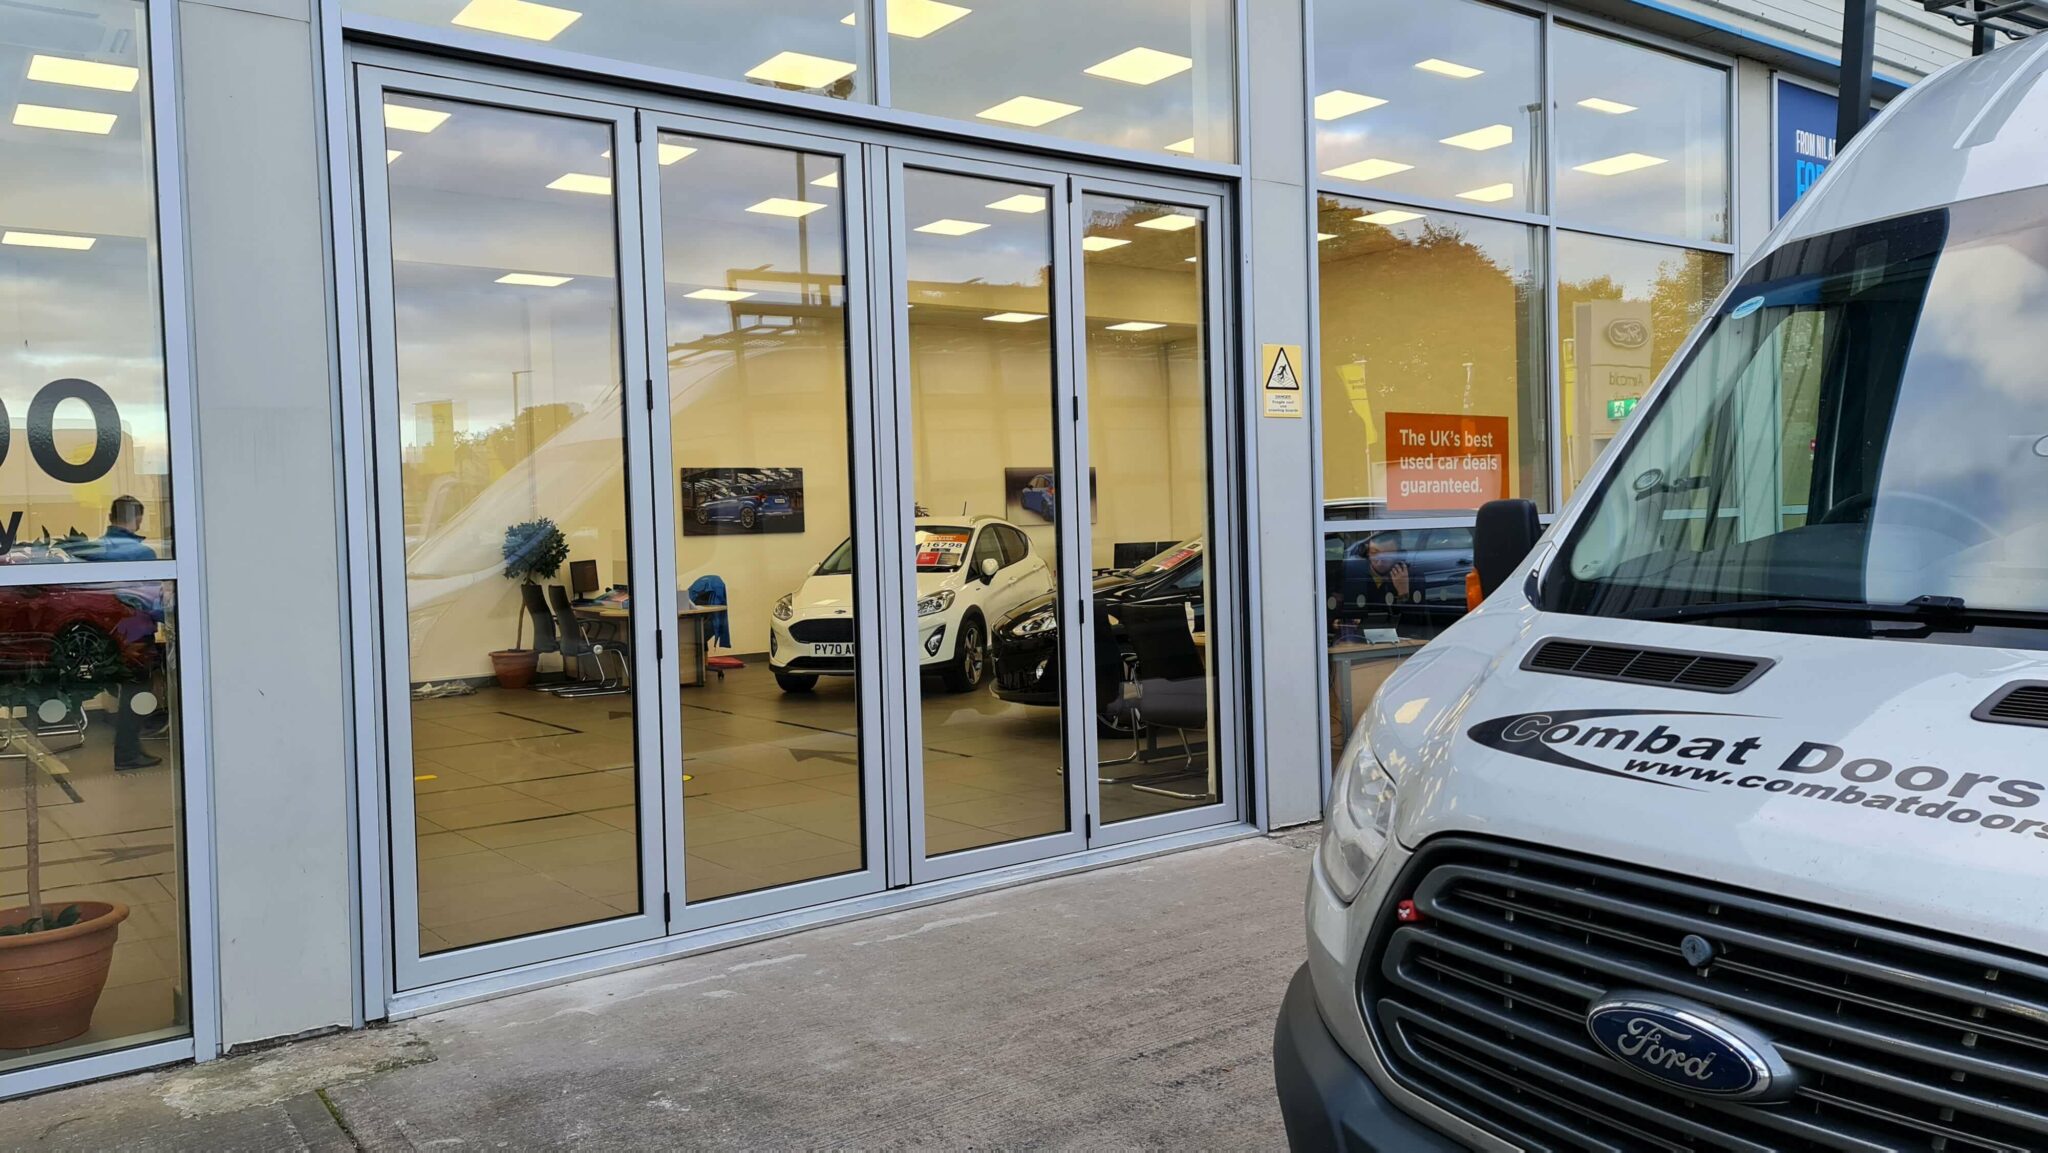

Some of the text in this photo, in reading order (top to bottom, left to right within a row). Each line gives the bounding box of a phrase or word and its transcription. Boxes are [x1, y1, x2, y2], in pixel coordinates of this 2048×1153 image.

[1796, 130, 1816, 156] FROM
[1816, 134, 1828, 160] NIL
[1399, 429, 1426, 446] The
[1464, 432, 1493, 448] best
[1400, 453, 1498, 471] used car deals
[1400, 476, 1483, 497] guaranteed.
[814, 643, 842, 655] PY70
[1501, 714, 2045, 808] Combat Doors
[1618, 1017, 1713, 1081] Ford
